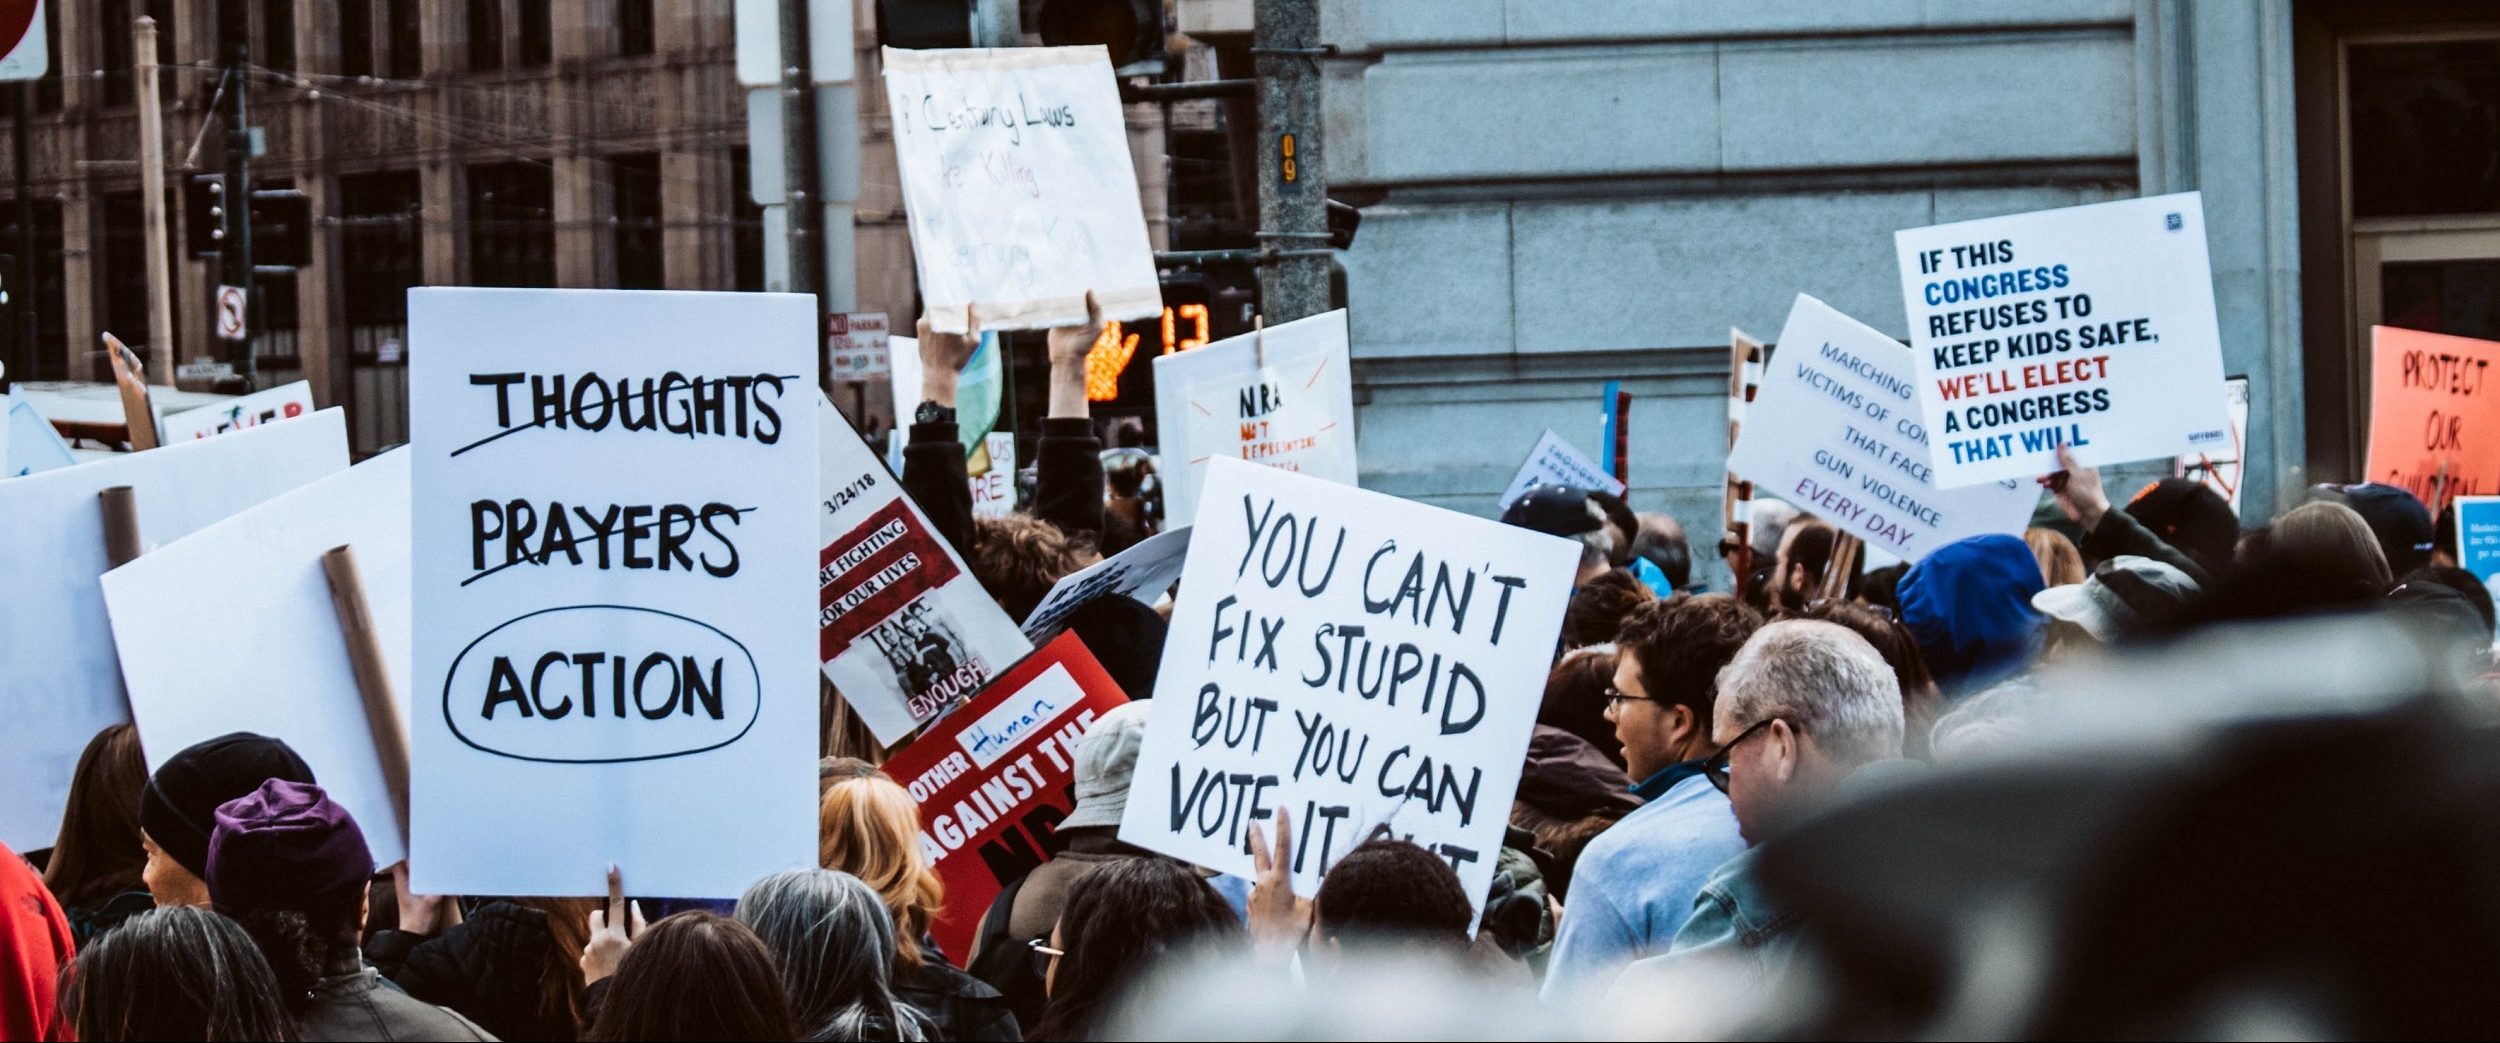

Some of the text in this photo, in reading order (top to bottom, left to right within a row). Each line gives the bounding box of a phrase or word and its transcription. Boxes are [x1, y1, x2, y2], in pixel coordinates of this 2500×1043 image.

[923, 94, 1020, 146] Century
[1018, 92, 1075, 128] Laws
[1920, 239, 2015, 275] IF THIS
[1924, 264, 2070, 306] CONGRESS
[1929, 293, 2092, 338] REFUSES TO
[1933, 317, 2160, 370] KEEP KIDS SAFE,
[1241, 382, 1282, 417] NRA
[1797, 362, 1865, 409] VICTIMS
[1866, 402, 1890, 421] OF
[1820, 341, 1914, 400] MARCHING
[1937, 355, 2110, 402] WE'LL ELECT
[2402, 349, 2489, 396] PROTECT
[469, 371, 784, 445] THOUGHTS
[1945, 388, 2111, 434] A CONGRESS
[2426, 409, 2463, 452] OUR
[1845, 425, 1933, 483] THAT FACE
[1949, 423, 2089, 465] THAT WILL
[823, 472, 877, 515] 3/24/18
[1795, 478, 1915, 551] EVERY DAY.
[1815, 450, 1942, 528] GUN VIOLENCE
[471, 498, 741, 577] PRAYERS
[820, 519, 906, 588] RE FIGHTING
[845, 579, 879, 607] OUR
[877, 554, 919, 588] LIVES
[1238, 494, 1527, 646] YOU CAN'T
[480, 651, 725, 721] ACTION
[1208, 594, 1285, 673] FIX
[1301, 623, 1486, 735] STUPID
[973, 699, 1054, 757] Human
[1191, 682, 1482, 828] BUT YOU CAN
[917, 753, 1048, 868] AGAINST
[1170, 759, 1280, 856] VOTE
[1293, 800, 1350, 883] IT
